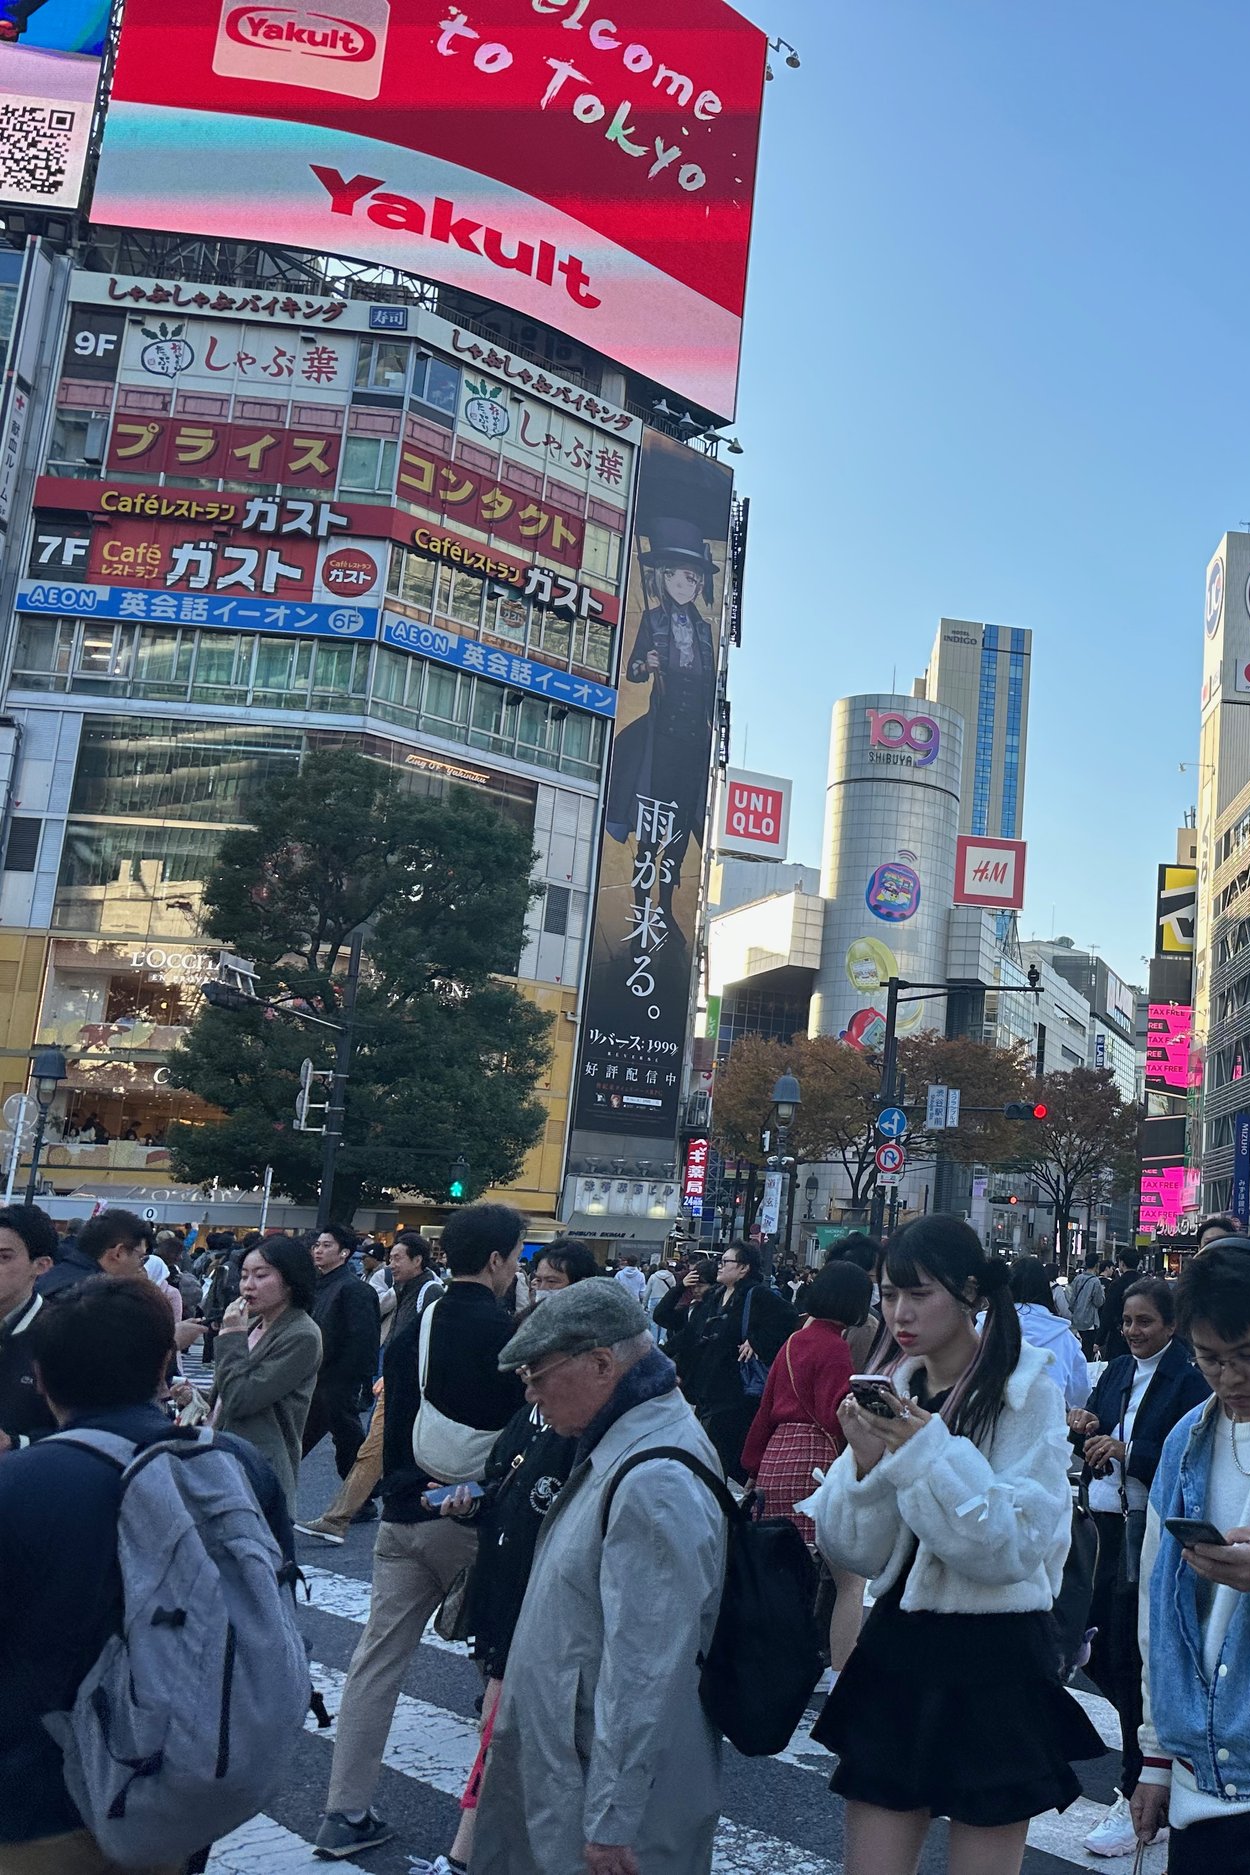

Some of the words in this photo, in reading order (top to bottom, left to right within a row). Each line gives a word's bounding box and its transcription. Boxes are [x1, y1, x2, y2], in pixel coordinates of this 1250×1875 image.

[245, 13, 363, 55] Yakult
[437, 7, 513, 75] to
[540, 57, 707, 193] Tokyo
[309, 163, 602, 310] Yakult
[108, 276, 348, 323] しゃぶしゃぶバイキング
[373, 308, 404, 327] 寿司
[74, 330, 118, 357] 9F
[204, 335, 339, 384] しゃぶ葉
[452, 328, 633, 432] しゃぶしゃぶバイキング
[116, 422, 332, 475] プライス
[521, 409, 624, 486] しゃぶ葉
[241, 496, 349, 538] ガスト
[401, 452, 577, 550] コンタクト
[37, 535, 90, 565] 7F
[102, 540, 162, 566] Café
[101, 564, 158, 579] レストラン
[165, 541, 304, 594] ガスト
[328, 569, 372, 584] ガスト
[30, 588, 98, 609] AEON
[525, 567, 604, 618] ガスト
[119, 591, 319, 629] 英会話イーオン
[332, 610, 362, 630] 6F
[395, 622, 449, 655] AEON
[463, 643, 613, 710] 英会話イーオン
[865, 709, 941, 768] 109
[868, 750, 914, 768] SHIBUYA
[734, 789, 773, 815] UNI
[732, 811, 775, 839] QLO
[972, 859, 1009, 885] H&M
[620, 792, 683, 1020] 雨が来る。
[1149, 1008, 1166, 1017] TAX
[1148, 1036, 1164, 1044] TAX
[584, 1061, 677, 1087] 好評配信中
[1146, 1064, 1163, 1072] TAX
[1163, 1065, 1183, 1073] FREE
[1241, 1122, 1249, 1156] MIZUHO
[1142, 1180, 1158, 1188] TAX
[1140, 1209, 1156, 1218] TAX
